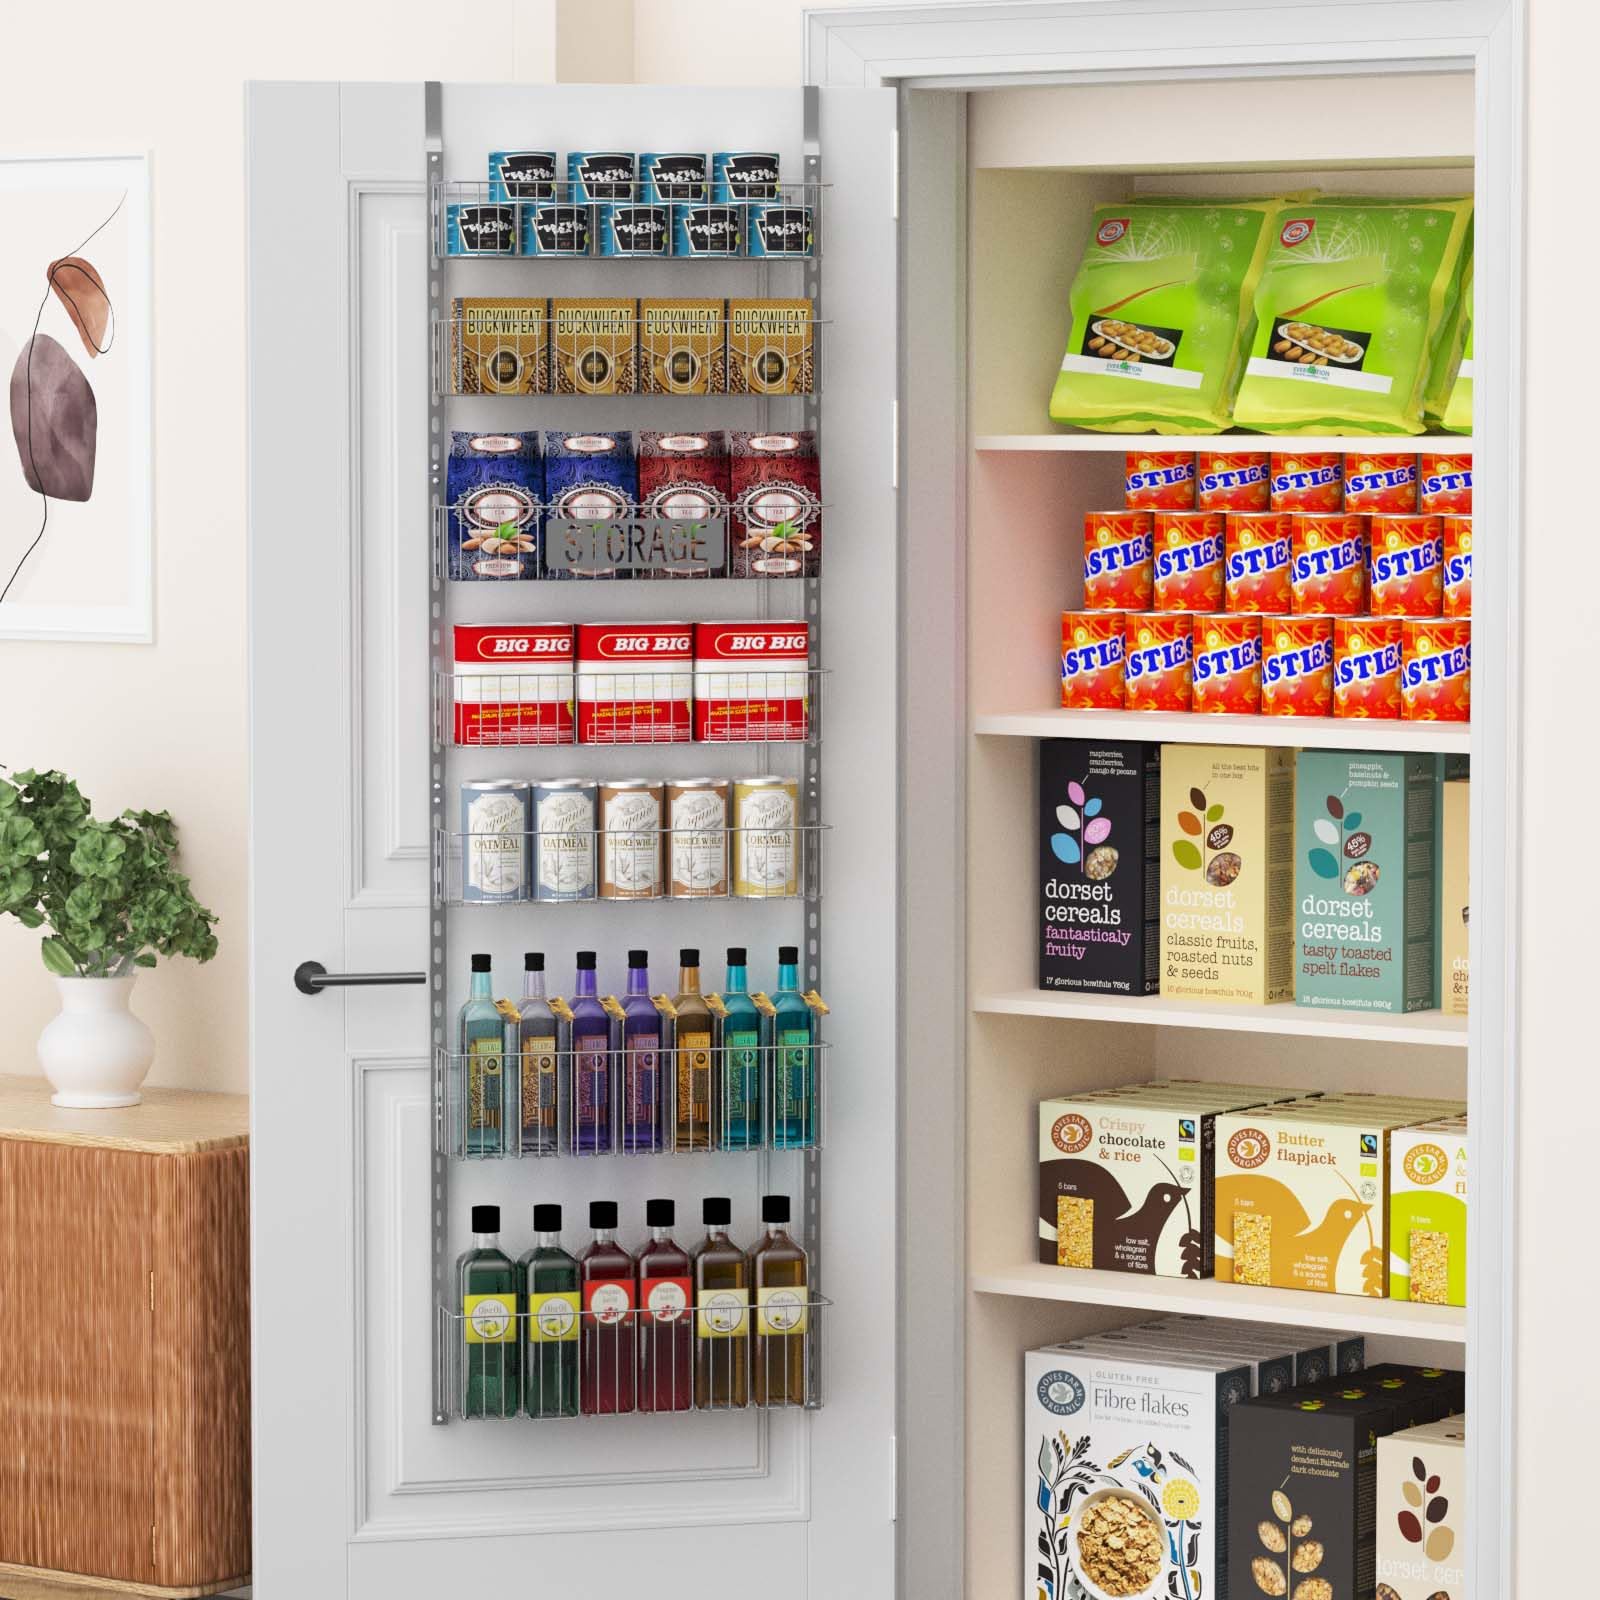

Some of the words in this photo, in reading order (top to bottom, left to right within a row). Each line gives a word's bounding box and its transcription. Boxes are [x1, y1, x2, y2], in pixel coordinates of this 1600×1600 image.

[468, 310, 541, 334] BUCKWHEAT
[558, 310, 630, 334] BUCKWHEAT
[646, 310, 718, 333] BUCKWHEAT
[735, 310, 806, 334] BUCKWHEAT
[565, 524, 708, 564] STORAGE
[493, 639, 529, 653] BIG
[532, 638, 571, 653] BIG
[613, 637, 649, 651] BIG
[652, 637, 690, 651] BIG
[730, 636, 766, 650] BIG
[769, 636, 806, 650] BIG
[1089, 767, 1109, 776] mango
[1116, 768, 1137, 777] pecans
[474, 838, 520, 849] OATMEAL
[543, 838, 588, 848] OATMEAL
[1045, 879, 1113, 902] dorset
[1166, 885, 1236, 909] dorset
[1045, 904, 1121, 925] cereals
[1302, 895, 1373, 919] dorset
[1165, 911, 1243, 932] cereals
[1045, 925, 1131, 946] fantasticaly
[1302, 921, 1382, 943] cereals
[1166, 933, 1213, 948] classic
[1216, 935, 1258, 952] fruits,
[1045, 943, 1086, 960] fruity
[1166, 949, 1218, 964] roasted
[1221, 952, 1253, 966] nuts
[1302, 943, 1337, 960] tasty
[1341, 945, 1392, 962] toasted
[1166, 964, 1178, 977] &
[1181, 965, 1219, 980] seeds
[1302, 962, 1337, 978] spelt
[1339, 963, 1380, 978] flakes
[1046, 976, 1054, 984] 17
[1054, 977, 1082, 986] glorious
[1083, 979, 1112, 988] bowlfuls
[1311, 996, 1341, 1005] glorious
[1098, 1116, 1145, 1135] Crispy
[1098, 1133, 1166, 1150] chocolate
[1276, 1131, 1325, 1148] Butter
[1098, 1149, 1110, 1160] &
[1114, 1149, 1141, 1163] rice
[1277, 1149, 1337, 1167] flapjack
[1058, 1182, 1063, 1190] 5
[1063, 1182, 1077, 1191] bars
[1125, 1236, 1137, 1244] low
[1114, 1244, 1147, 1255] wholegrain
[1125, 1253, 1147, 1262] source
[1127, 1261, 1134, 1269] of
[1135, 1261, 1149, 1270] fibre
[1039, 1372, 1063, 1393] DOVES
[1064, 1374, 1083, 1397] FARM
[1095, 1370, 1132, 1381] GLUTEN
[1136, 1375, 1159, 1385] FREE
[1042, 1397, 1081, 1414] ORGANIC
[1095, 1388, 1137, 1411] Fibre
[1141, 1392, 1189, 1417] flakes
[1291, 1445, 1307, 1454] with
[1307, 1446, 1343, 1459] deliciously
[1291, 1465, 1307, 1474] dark
